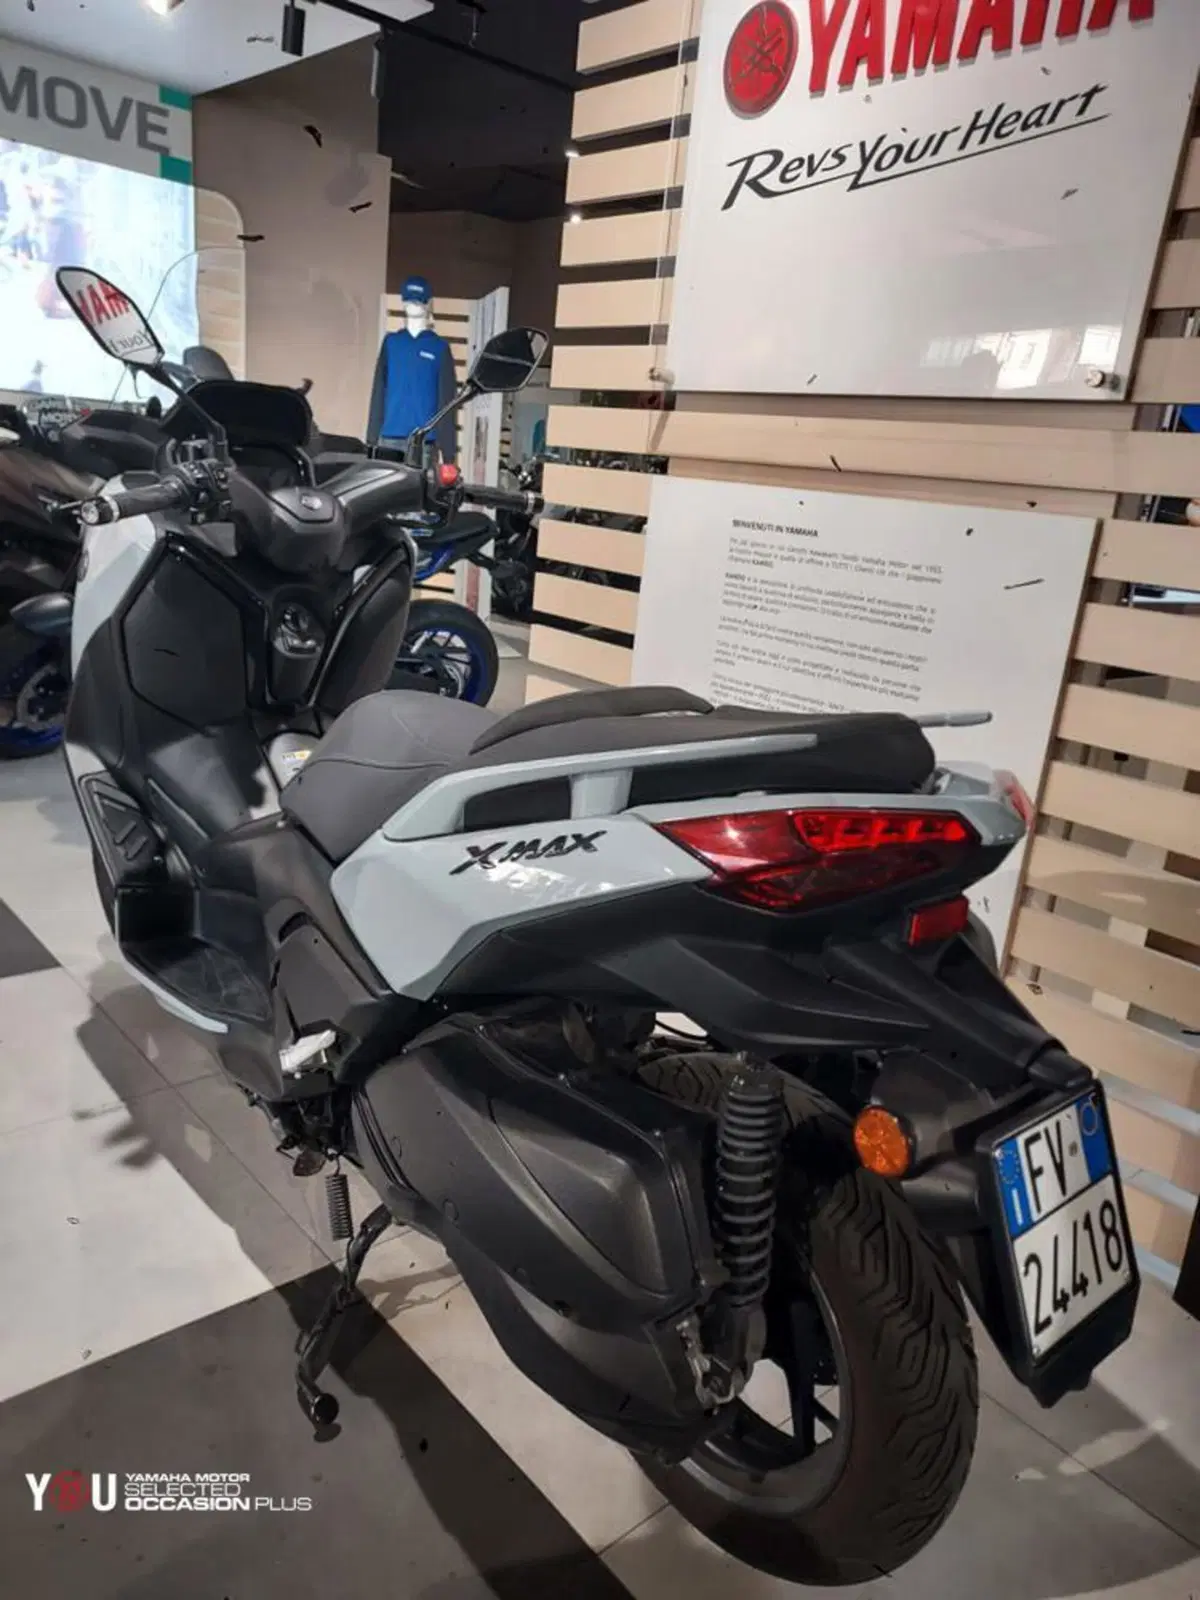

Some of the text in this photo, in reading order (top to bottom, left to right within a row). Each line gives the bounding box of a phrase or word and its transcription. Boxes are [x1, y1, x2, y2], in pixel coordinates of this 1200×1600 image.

[809, 0, 1154, 94] YAMA
[0, 65, 172, 157] MOVE
[721, 83, 1107, 211] Revs Your Heart
[785, 526, 819, 538] YAMAHA
[449, 830, 608, 876] XMAX
[1024, 1120, 1068, 1215] FV
[1023, 1199, 1123, 1336] 24418
